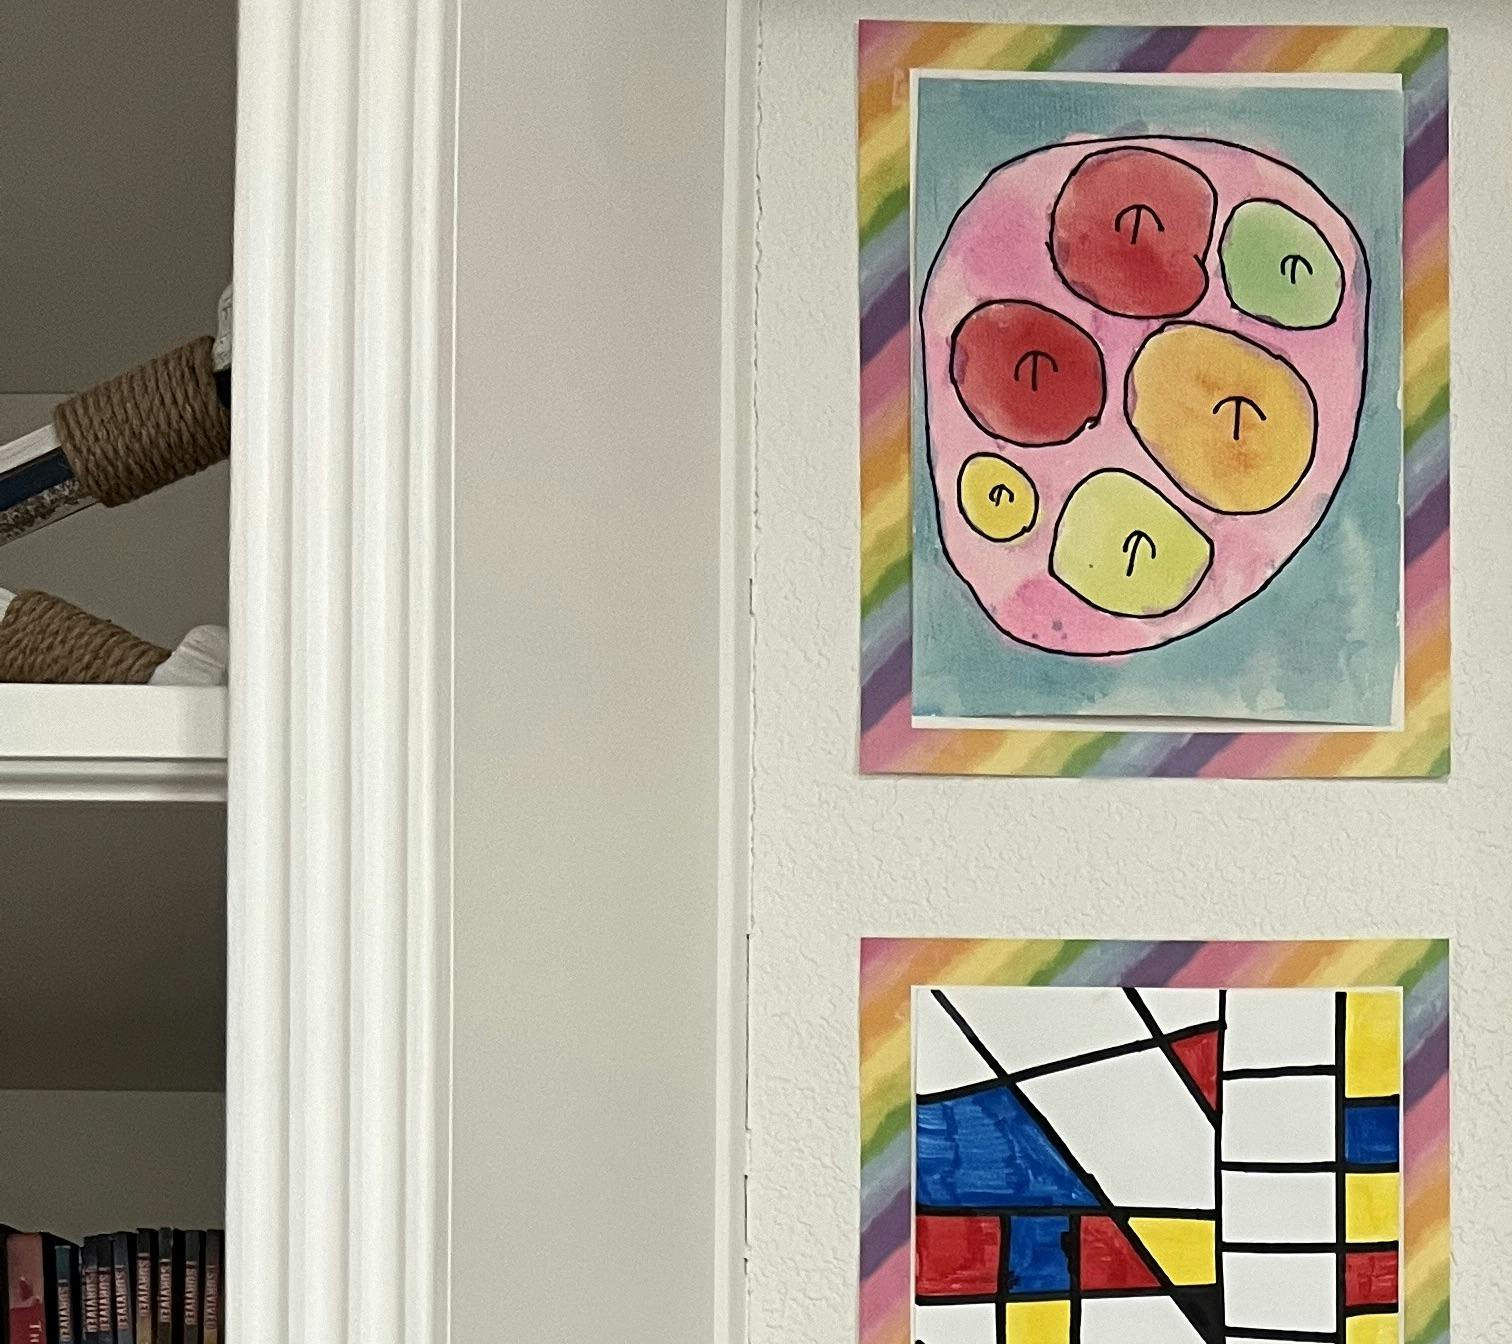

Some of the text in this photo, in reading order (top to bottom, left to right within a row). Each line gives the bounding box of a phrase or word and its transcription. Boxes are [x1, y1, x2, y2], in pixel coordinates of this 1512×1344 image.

[58, 1286, 73, 1343] SURVIVED
[86, 1273, 98, 1332] SURVIVED
[99, 1273, 111, 1331] SURVIVED
[115, 1271, 129, 1330] SURVIVED
[137, 1261, 151, 1317] SURVIVED
[160, 1265, 172, 1323] SURVIVED
[185, 1268, 198, 1325] SURVIVED
[204, 1272, 217, 1330] SURVIVED
